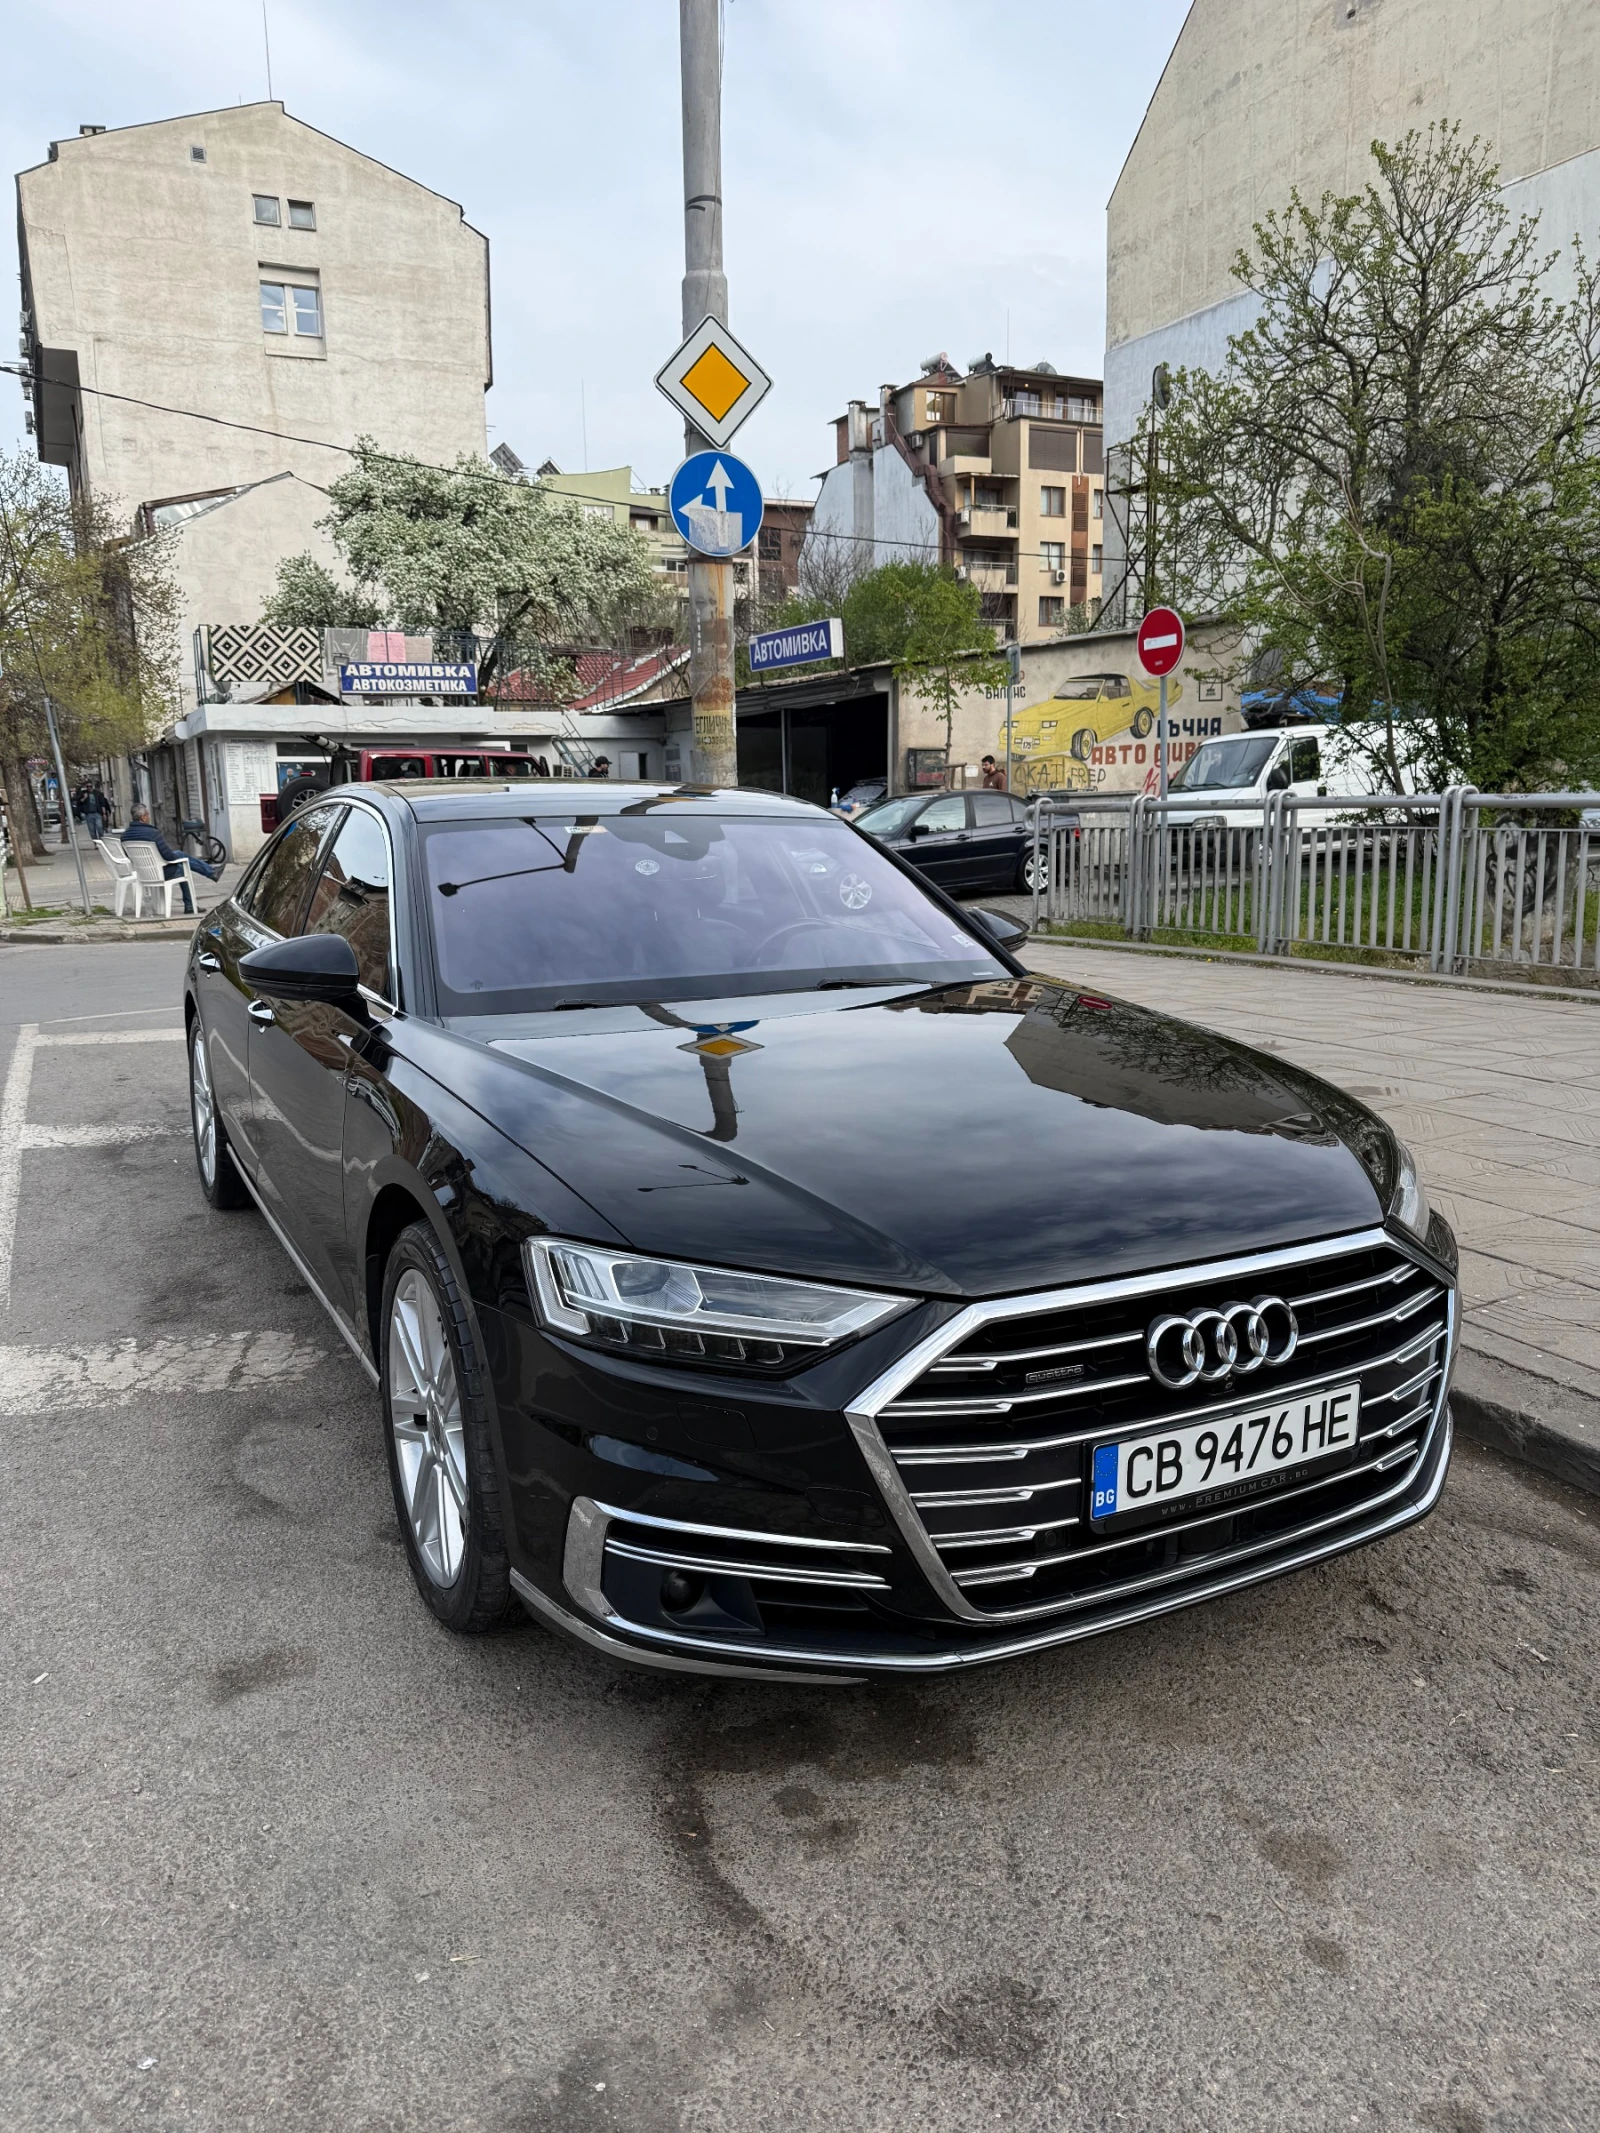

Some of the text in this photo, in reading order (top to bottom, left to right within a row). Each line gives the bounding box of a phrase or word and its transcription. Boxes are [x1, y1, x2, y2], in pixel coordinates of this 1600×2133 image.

[754, 628, 828, 663] АВТОМИВКА
[345, 664, 472, 678] АВТОМИВКА
[352, 678, 468, 692] АВТОКОЗМЕТИКА
[1091, 743, 1147, 766] АВТО
[1027, 1366, 1083, 1382] quattro
[1126, 1392, 1352, 1498] CB 9476 HE
[1095, 1488, 1115, 1508] BG
